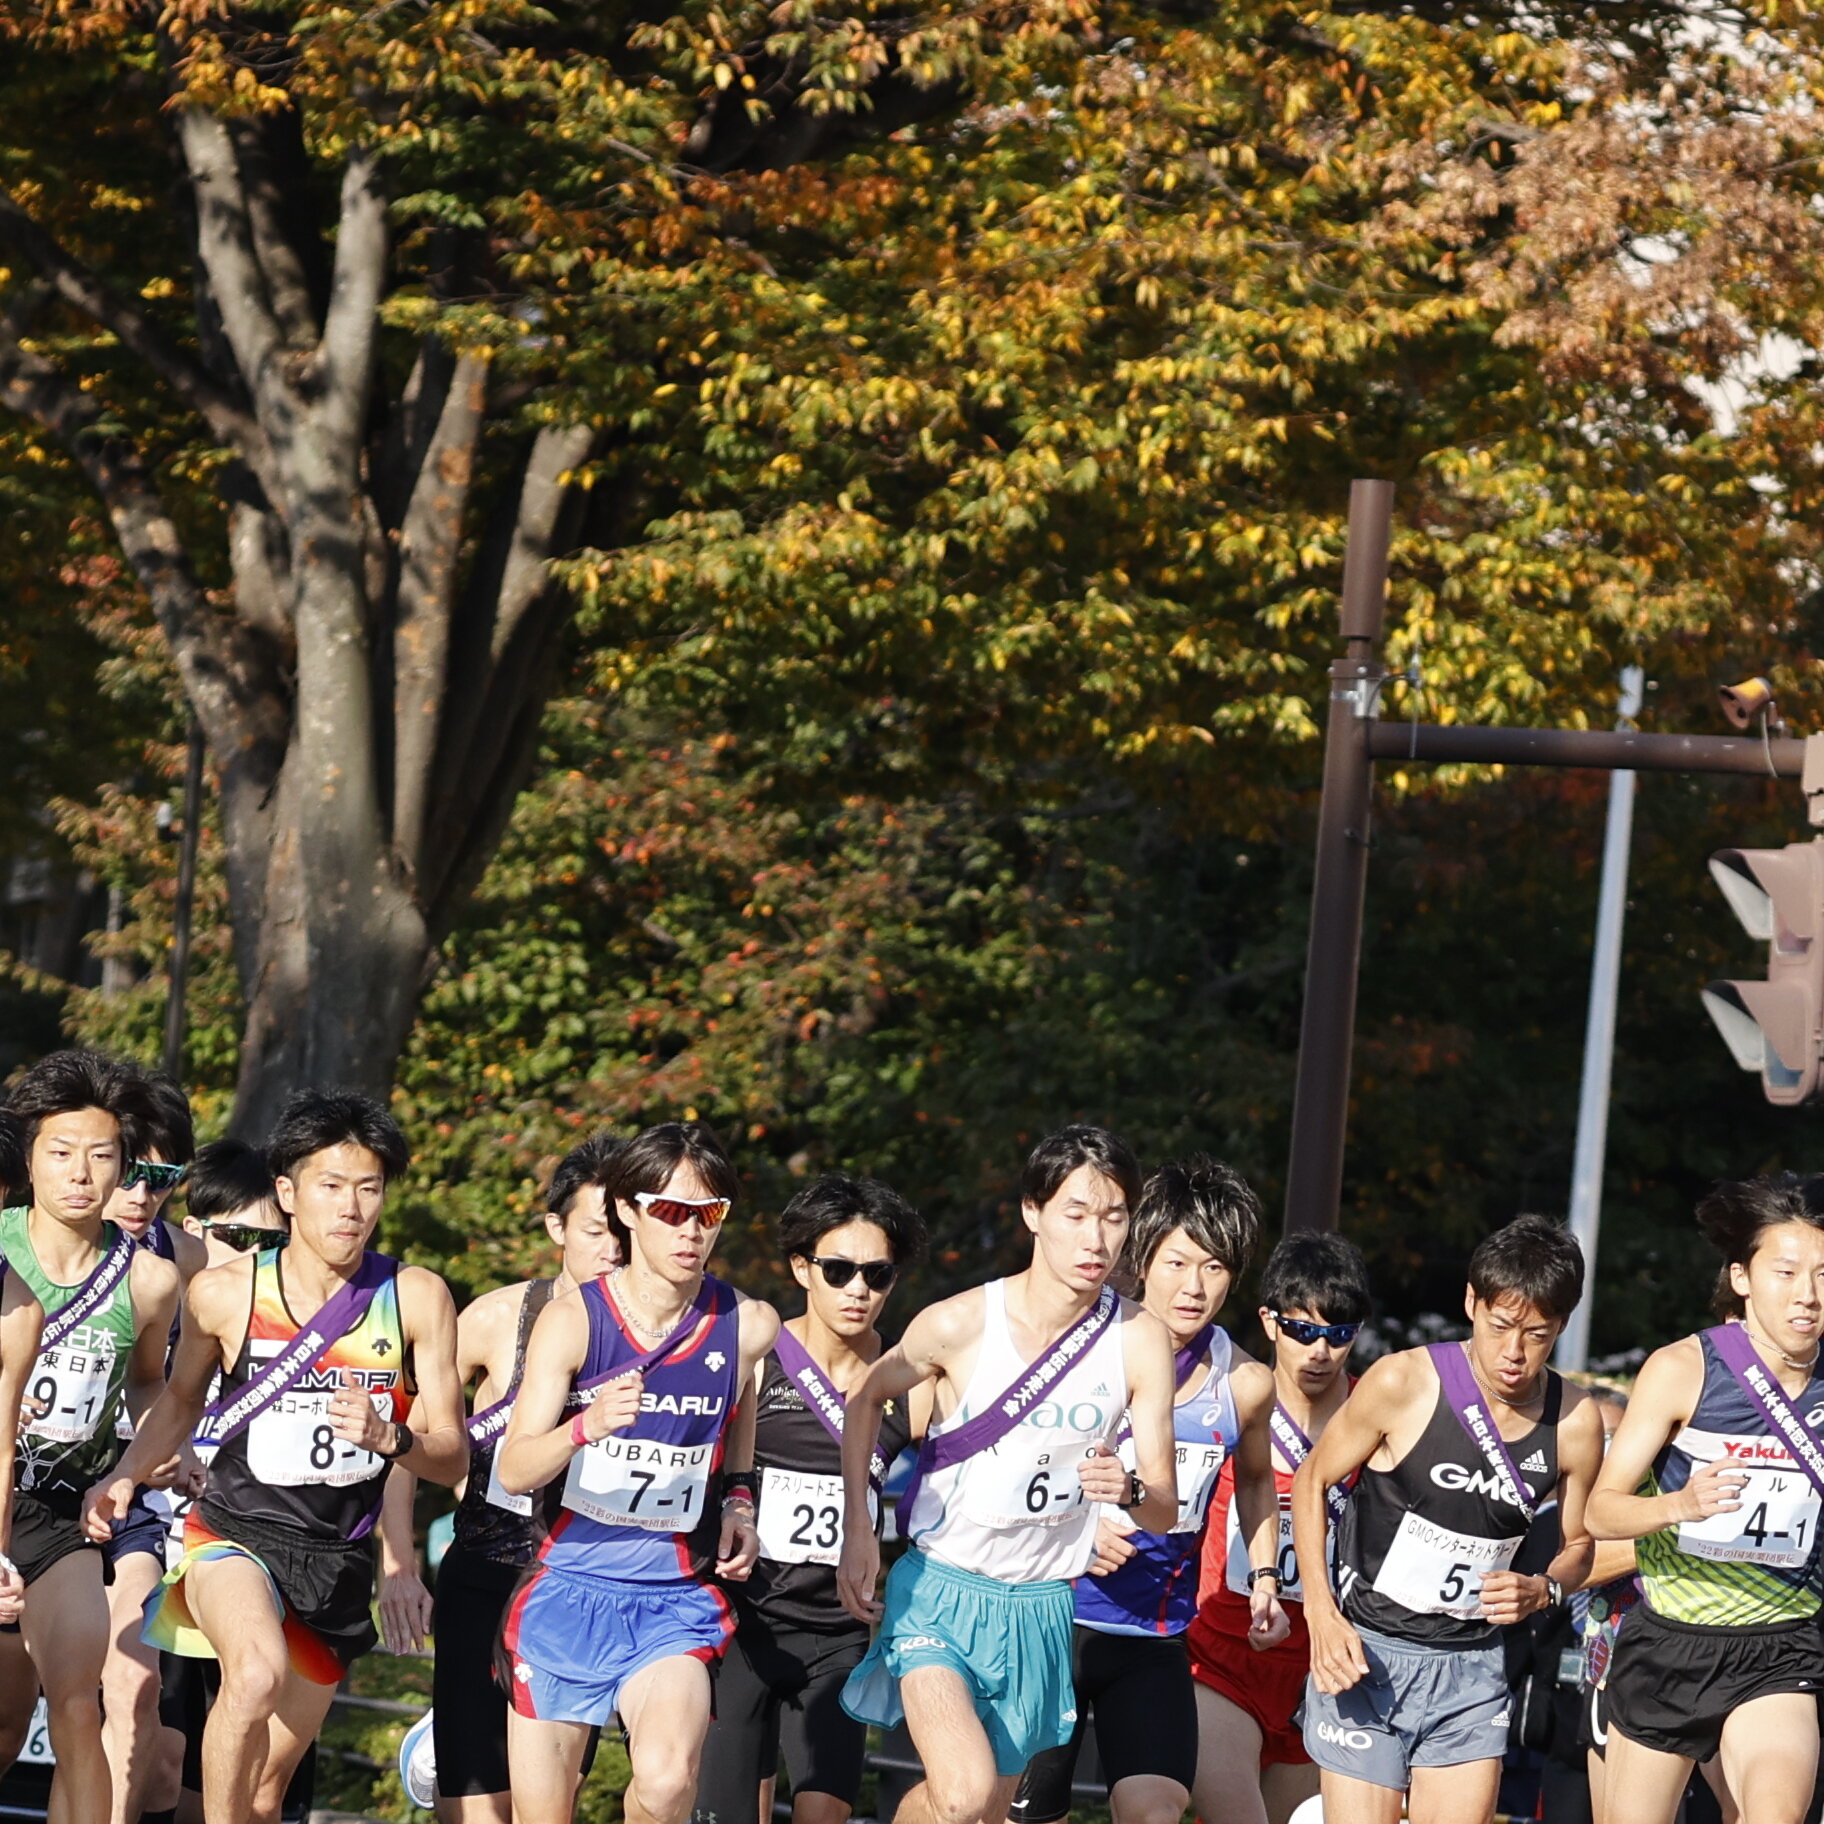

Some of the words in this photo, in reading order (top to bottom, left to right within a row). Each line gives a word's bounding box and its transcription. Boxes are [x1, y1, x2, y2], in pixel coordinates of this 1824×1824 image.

[31, 1376, 96, 1425] 9-1
[627, 1470, 694, 1514] 7-1
[1743, 1501, 1807, 1549] 4-1
[1317, 1721, 1373, 1750] GMO
